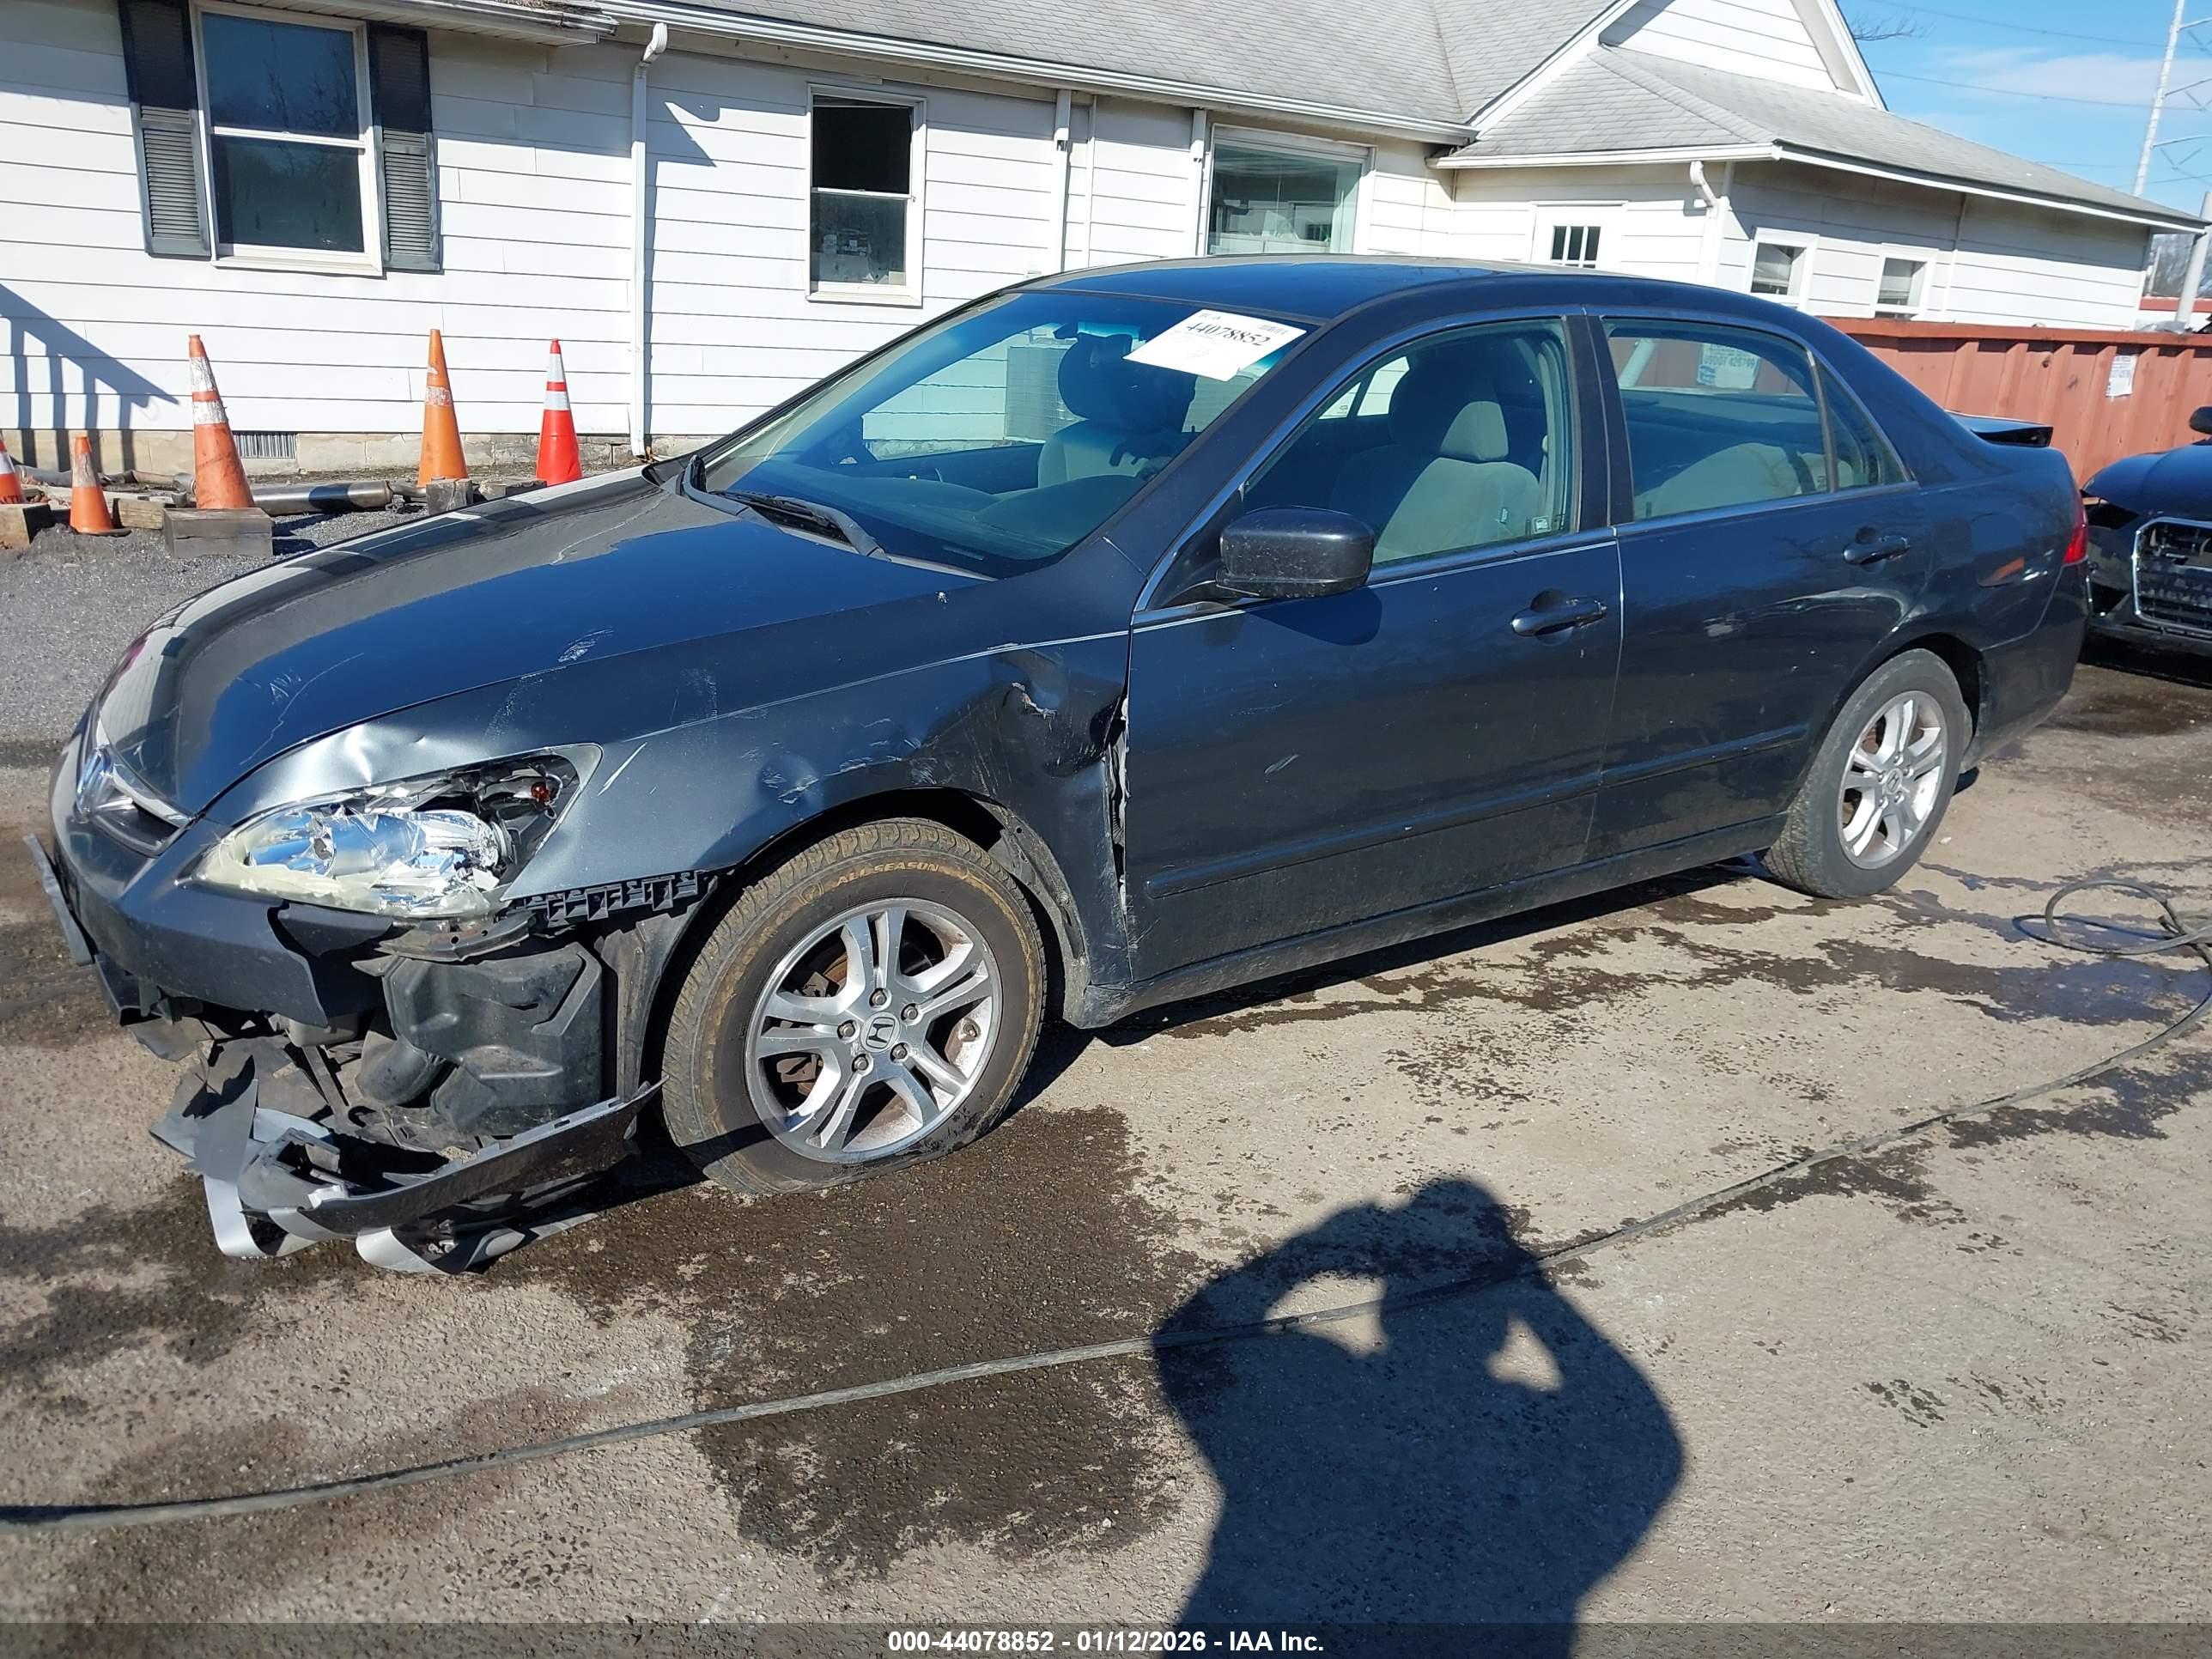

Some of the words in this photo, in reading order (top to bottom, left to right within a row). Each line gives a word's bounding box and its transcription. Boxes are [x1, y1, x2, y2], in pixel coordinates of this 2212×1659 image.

[1187, 322, 1272, 346] 44078852
[837, 868, 870, 887] ALL
[873, 861, 940, 874] SEASON
